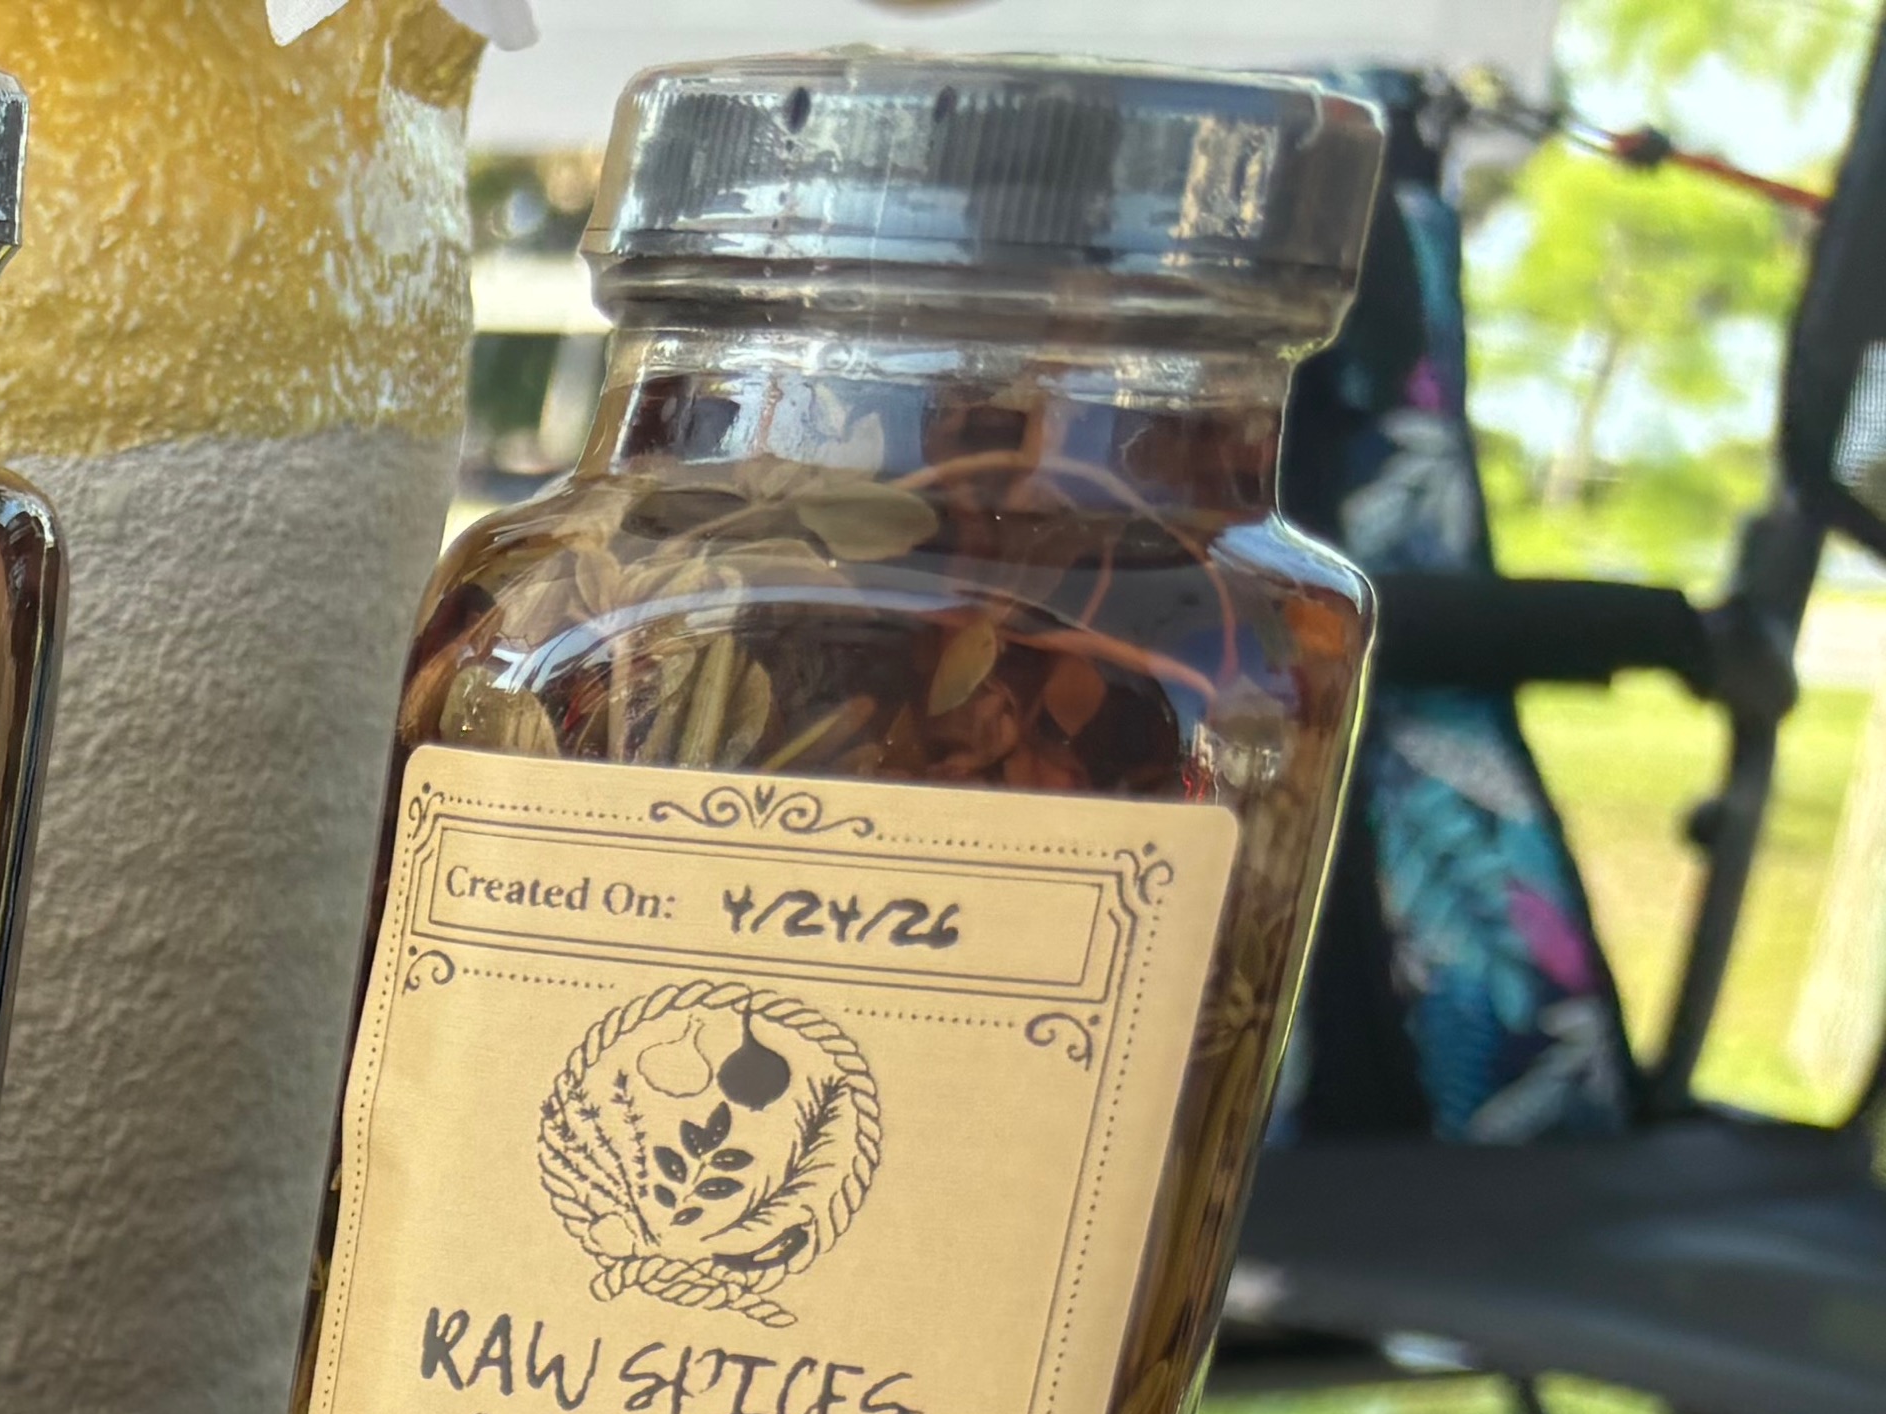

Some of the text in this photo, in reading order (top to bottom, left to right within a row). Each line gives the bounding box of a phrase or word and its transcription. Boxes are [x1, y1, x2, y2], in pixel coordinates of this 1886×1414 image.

[445, 865, 961, 949] Created On: 4/24/26
[420, 1306, 603, 1411] RAW
